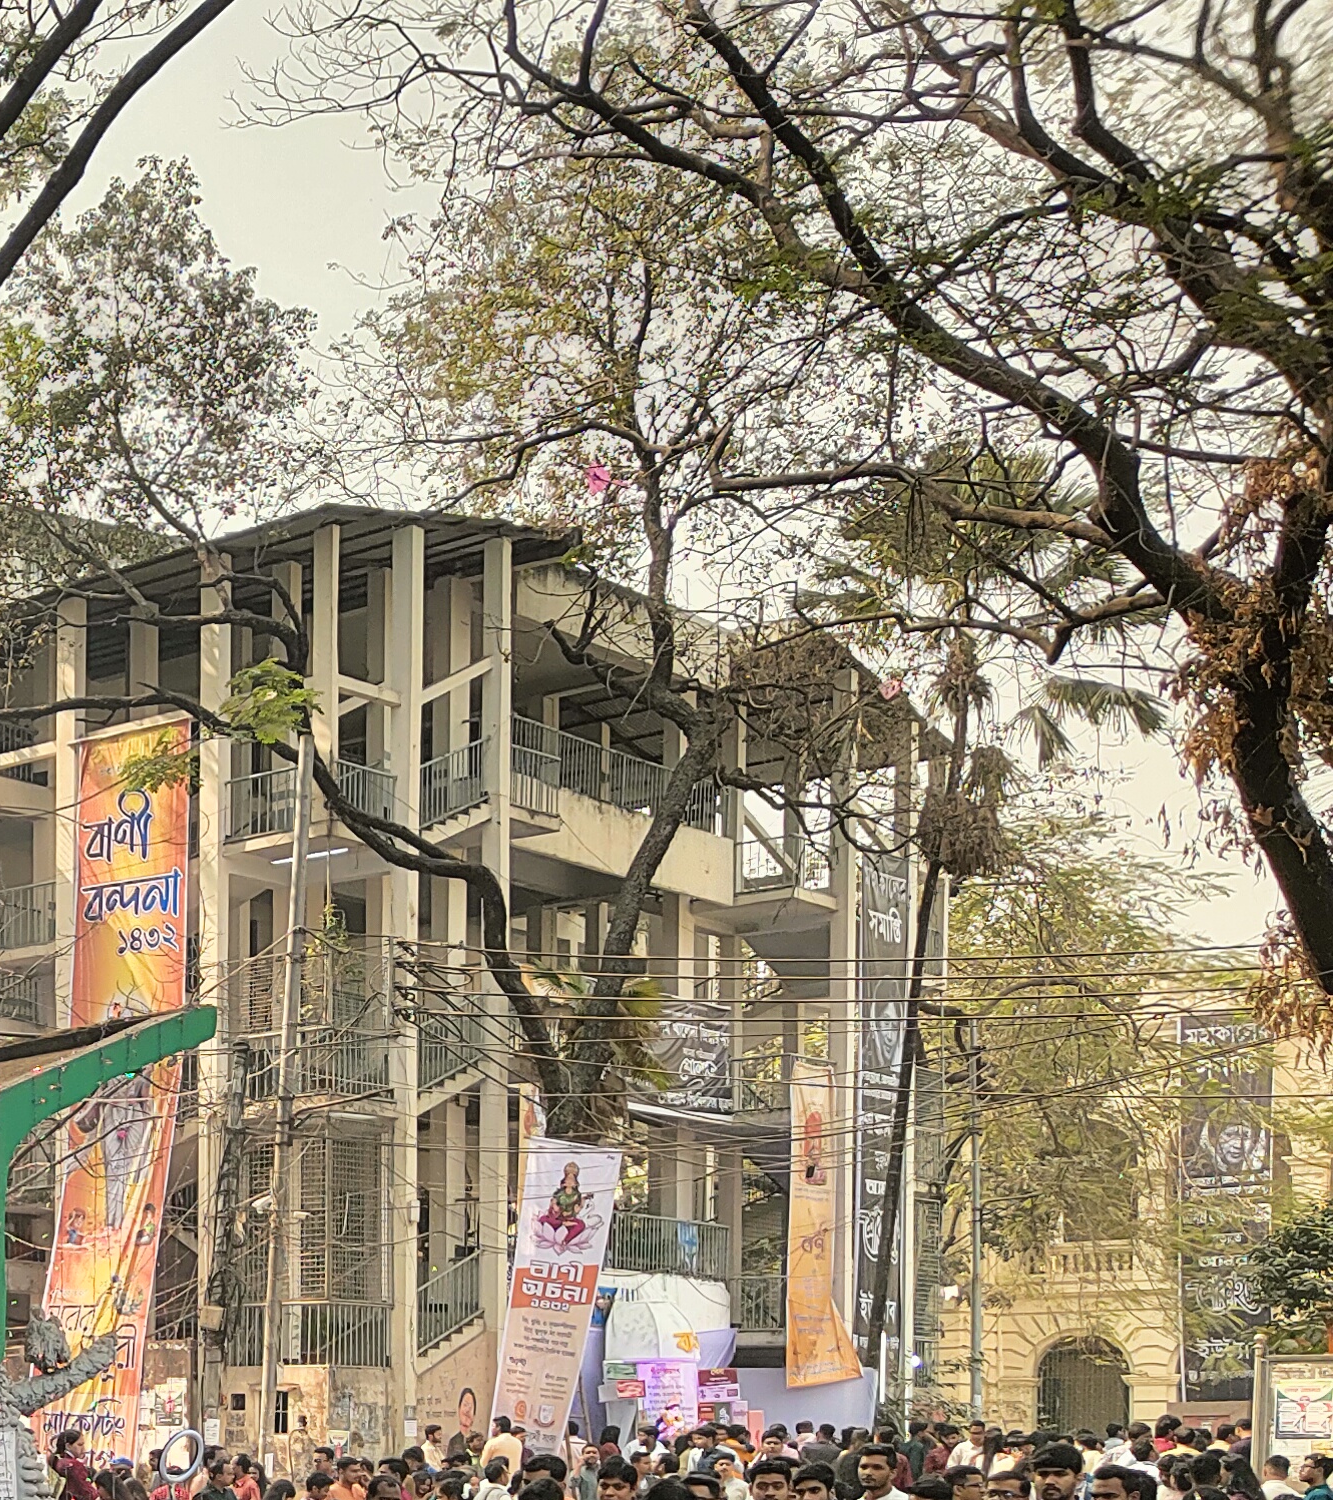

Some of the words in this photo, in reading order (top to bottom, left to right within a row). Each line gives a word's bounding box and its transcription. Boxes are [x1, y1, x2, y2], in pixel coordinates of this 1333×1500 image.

[82, 786, 153, 864] বাণী
[80, 867, 183, 922] বন্দনা
[116, 921, 179, 955] ১৪৩২
[867, 906, 903, 944] সমাপ্তি
[529, 1259, 584, 1284] বাণী
[521, 1276, 589, 1304] অর্চনা
[530, 1298, 570, 1313] ১৪৩২
